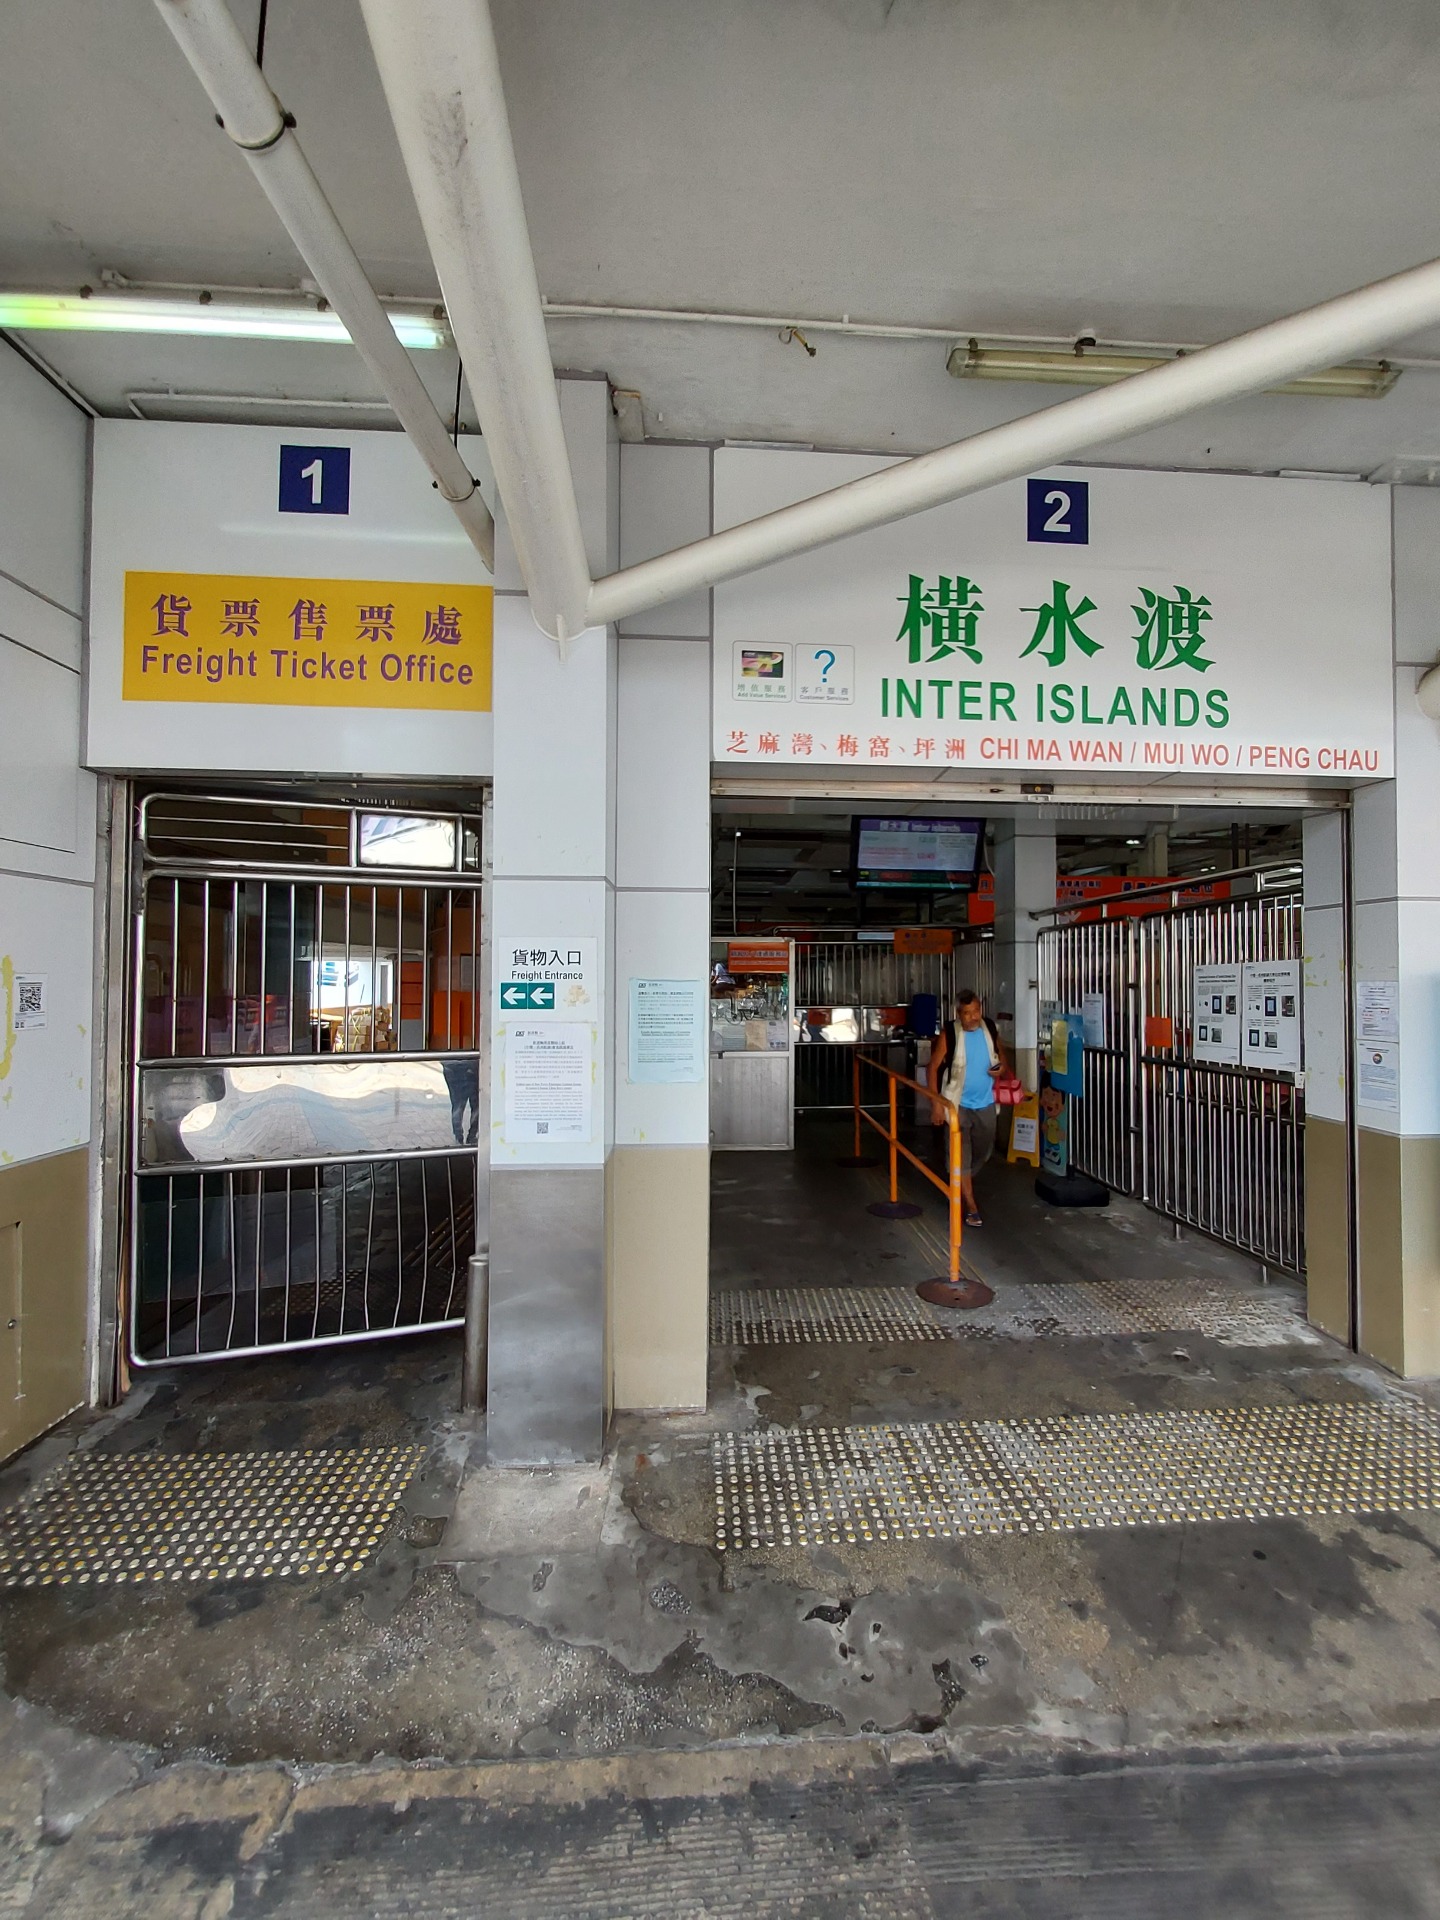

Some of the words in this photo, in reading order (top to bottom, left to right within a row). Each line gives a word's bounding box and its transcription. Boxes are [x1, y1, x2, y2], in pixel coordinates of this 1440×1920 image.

[301, 459, 323, 504] 1
[1043, 490, 1071, 533] 2
[150, 593, 463, 646] 貨票售票處
[895, 573, 1217, 673] 橫水渡
[141, 645, 258, 683] Freight
[270, 649, 368, 682] Ticket
[380, 653, 474, 685] Office
[881, 678, 1018, 722] INTER
[1035, 682, 1231, 730] ISLANDS
[979, 736, 1019, 759] CHI
[1026, 738, 1062, 761] MA
[1068, 739, 1123, 762] WAN
[1144, 742, 1186, 764] MUI
[1190, 744, 1230, 766] WO
[1249, 745, 1312, 769] PENG
[1317, 747, 1380, 771] CHAU
[511, 970, 543, 981] Freight
[544, 970, 583, 980] Entrance
[512, 949, 581, 966] 貨物入口
